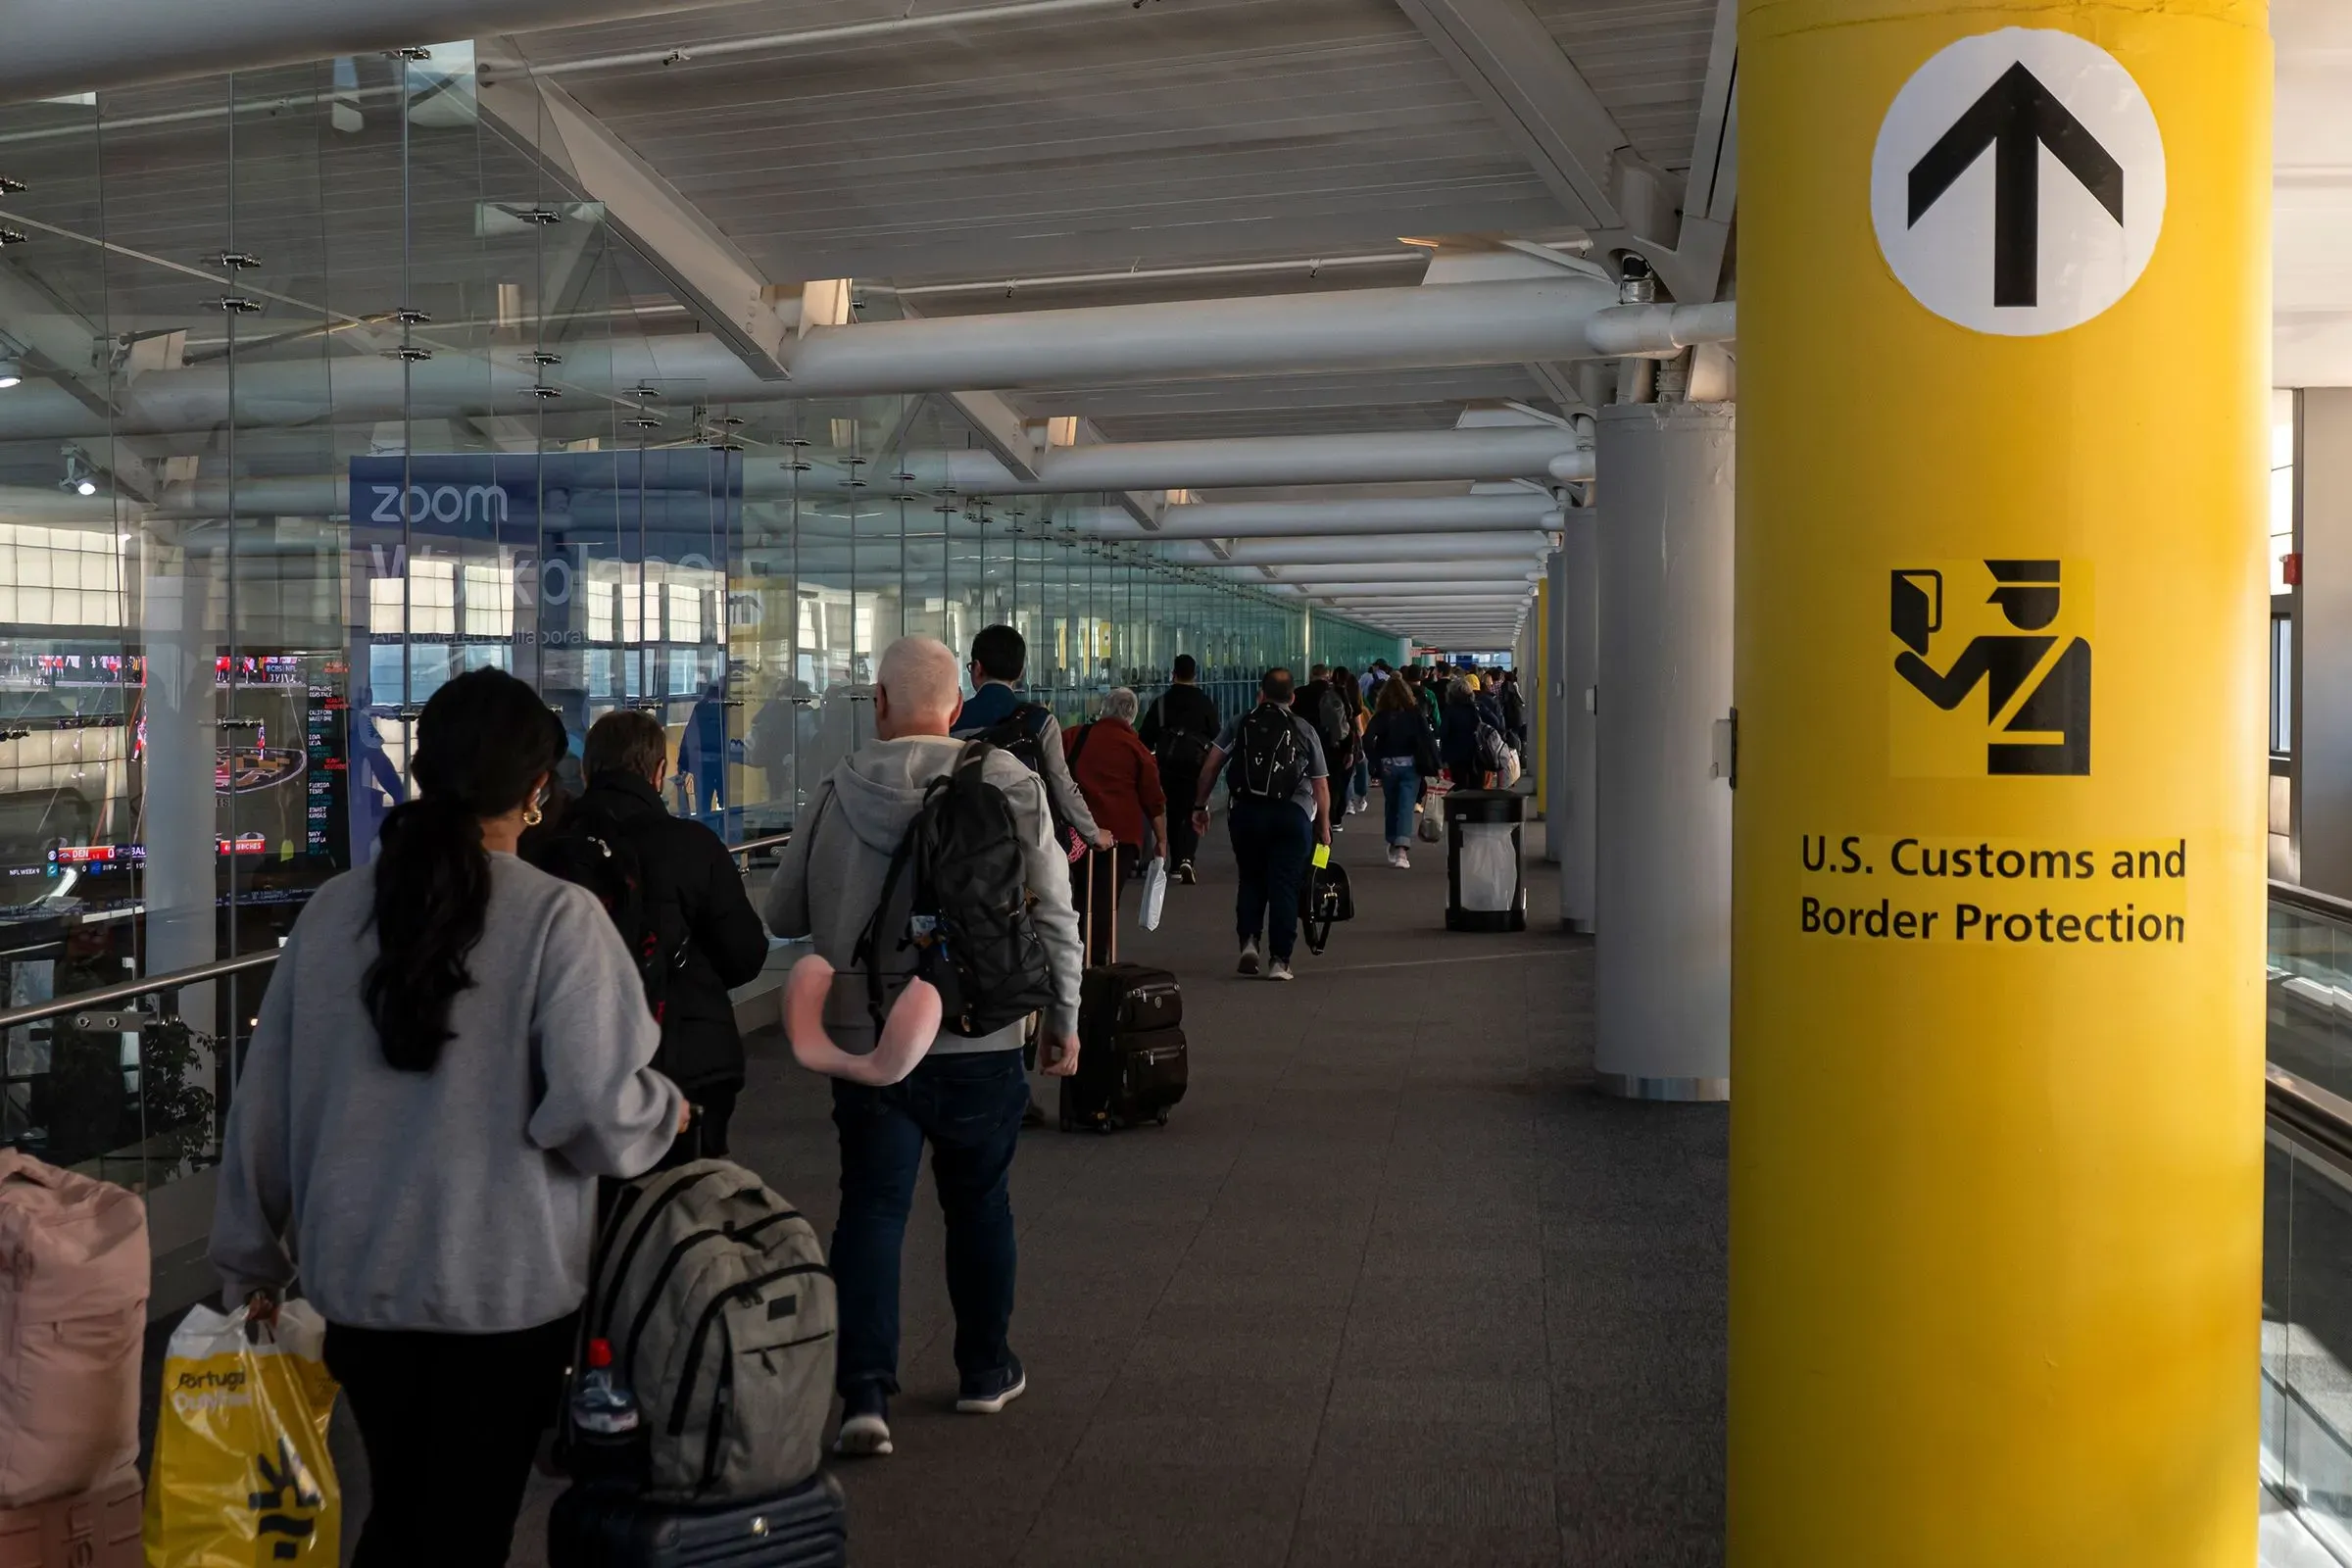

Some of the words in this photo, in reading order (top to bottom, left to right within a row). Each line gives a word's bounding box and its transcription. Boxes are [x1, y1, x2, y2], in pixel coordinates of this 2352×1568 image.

[370, 485, 509, 523] zoom
[371, 544, 715, 619] Wkplac
[372, 627, 480, 645] AI-owered
[72, 850, 89, 858] DEN
[107, 849, 115, 858] 0
[1802, 834, 1874, 875] U.S.
[1890, 838, 2095, 879] Customs
[2111, 838, 2186, 879] and
[1801, 897, 1939, 939] Border
[1956, 903, 2185, 944] Protection
